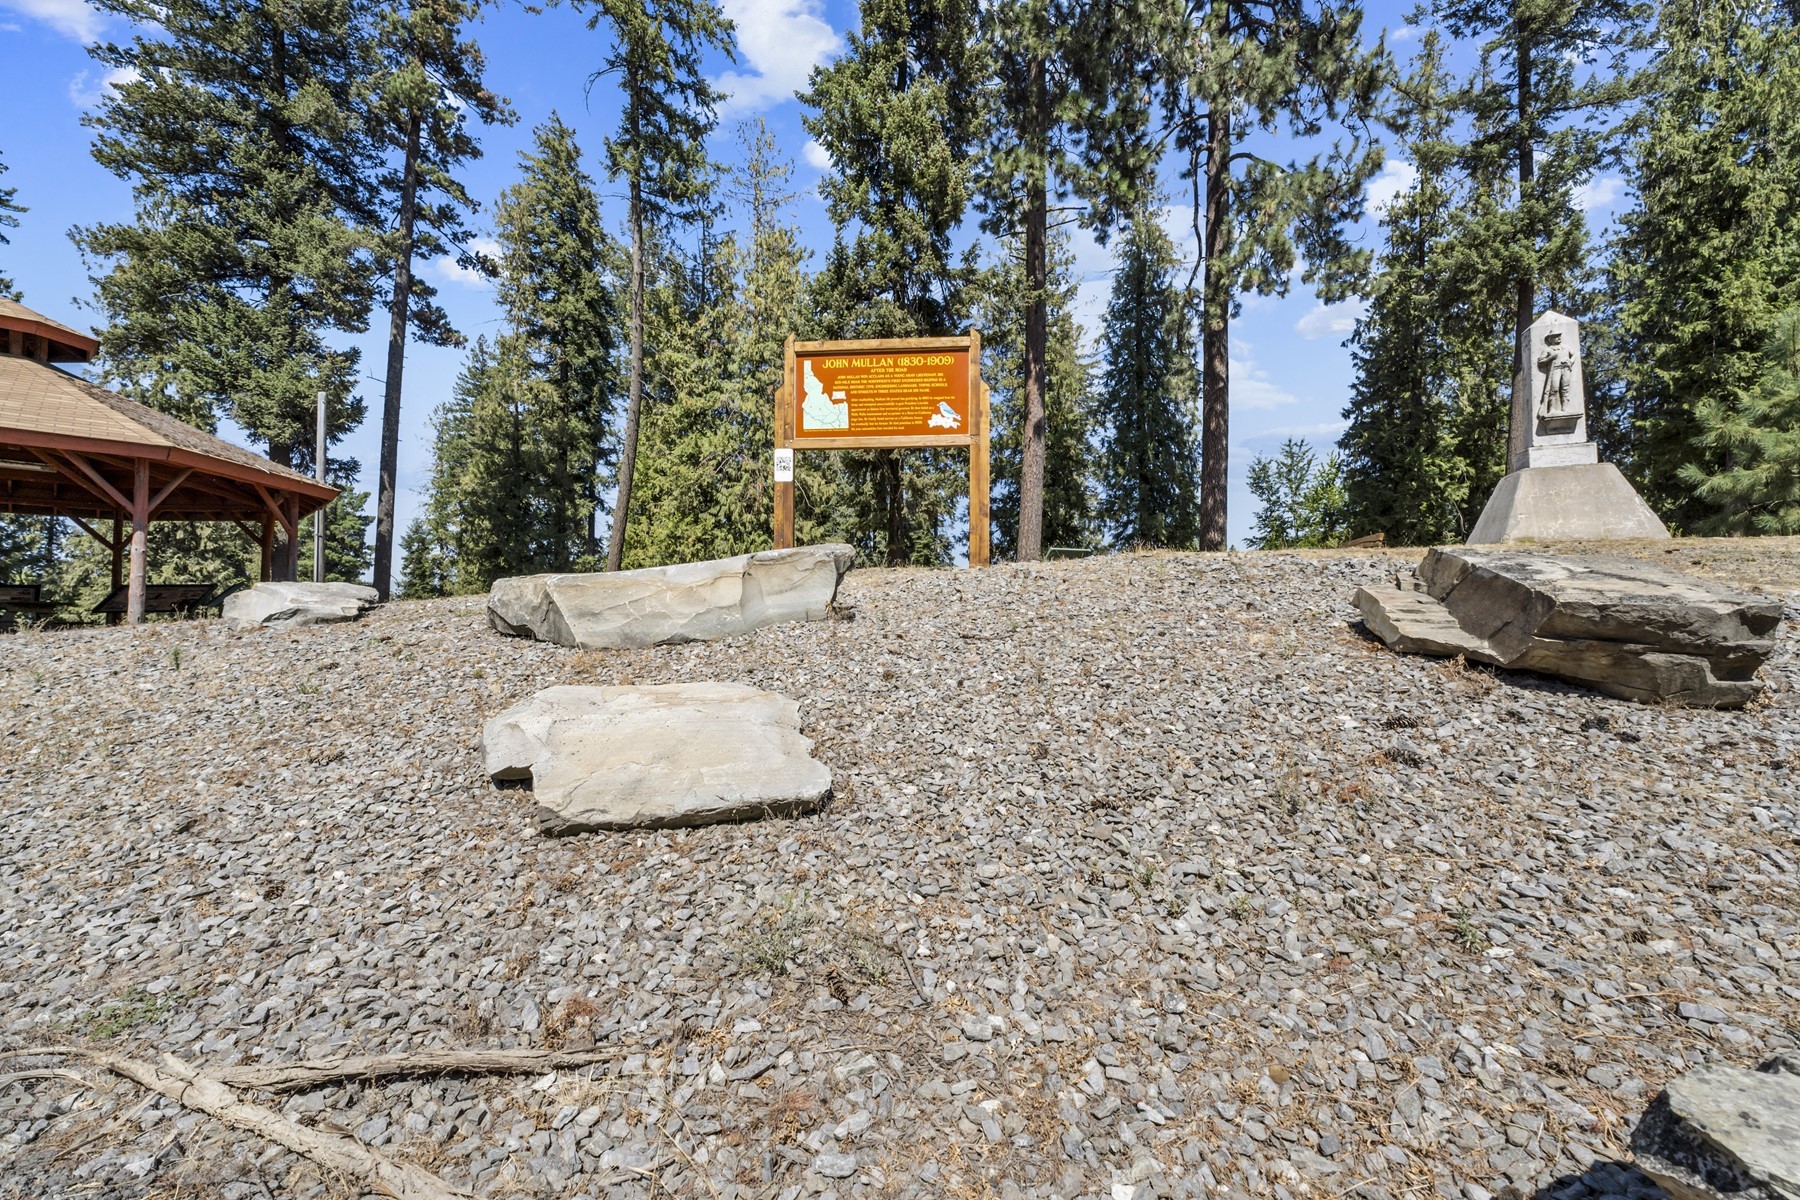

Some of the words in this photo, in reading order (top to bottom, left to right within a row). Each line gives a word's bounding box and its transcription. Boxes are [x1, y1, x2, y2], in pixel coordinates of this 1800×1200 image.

[823, 359, 848, 368] JOHN
[851, 357, 893, 367] MULLAN
[897, 356, 954, 366] (1830-1909)
